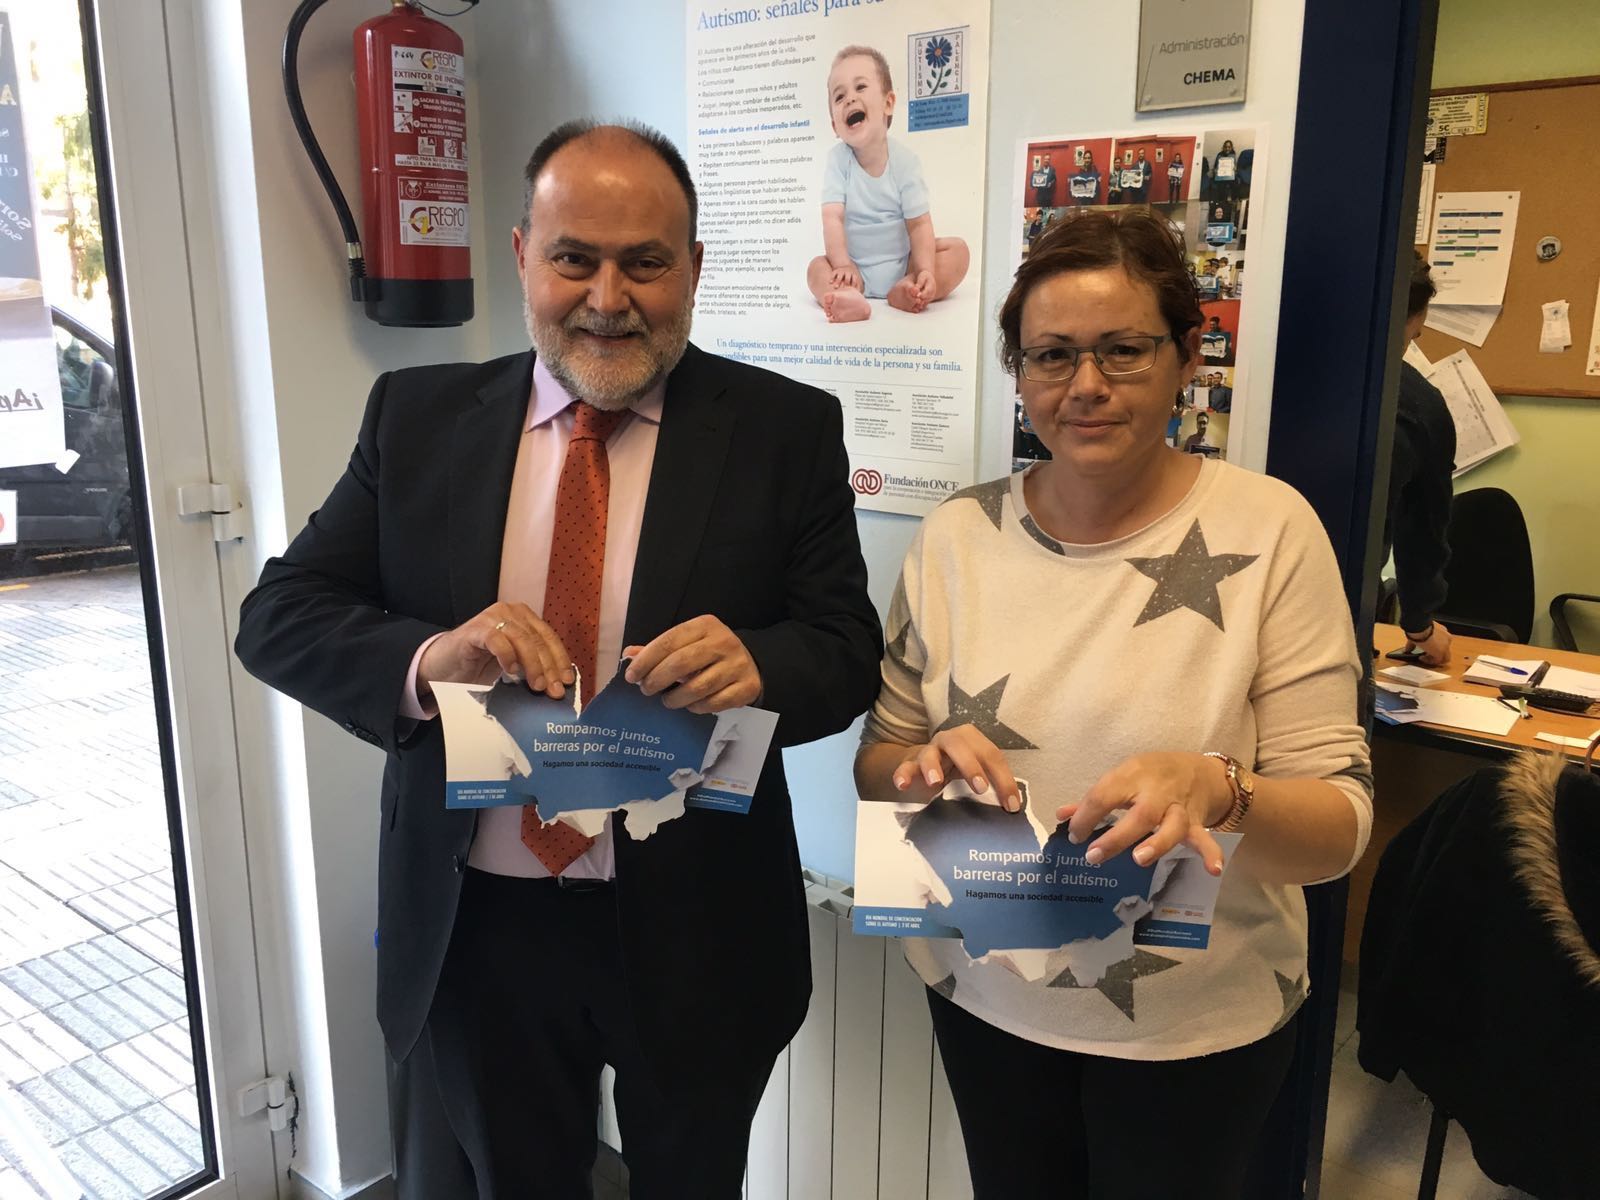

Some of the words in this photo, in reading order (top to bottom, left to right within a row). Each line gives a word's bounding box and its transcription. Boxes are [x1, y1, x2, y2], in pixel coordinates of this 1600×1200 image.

[697, 8, 761, 31] Autismo:
[1159, 32, 1245, 54] Administración
[394, 70, 432, 80] EXTINTOR
[1184, 68, 1235, 85] CHEMA
[760, 122, 788, 131] desarrollo
[717, 338, 727, 347] Un
[728, 339, 767, 350] diagnóstico
[768, 342, 803, 352] temprano
[804, 344, 808, 353] y
[810, 343, 824, 351] una
[826, 342, 872, 354] intervención
[875, 345, 927, 356] especializada
[752, 356, 767, 364] para
[784, 356, 804, 365] mejor
[805, 355, 832, 365] calidad
[834, 356, 842, 365] de
[844, 357, 861, 367] vida
[862, 358, 872, 367] de
[874, 358, 880, 368] la
[882, 360, 914, 370] persona
[915, 363, 920, 372] y
[933, 360, 962, 371] familia.
[884, 474, 928, 488] Fundación
[546, 722, 617, 737] Rompamos
[620, 728, 661, 744] juntos
[534, 739, 580, 752] barreras
[583, 742, 605, 755] por
[608, 743, 620, 753] el
[624, 746, 675, 760] autismo
[969, 849, 1051, 866] Rompamos
[953, 866, 1012, 882] barreras
[1017, 872, 1041, 886] por
[1045, 871, 1057, 884] el
[1061, 873, 1118, 888] autismo
[966, 890, 1007, 900] Hagamos
[1027, 892, 1063, 901] sociedad
[1066, 894, 1104, 903] accesible
